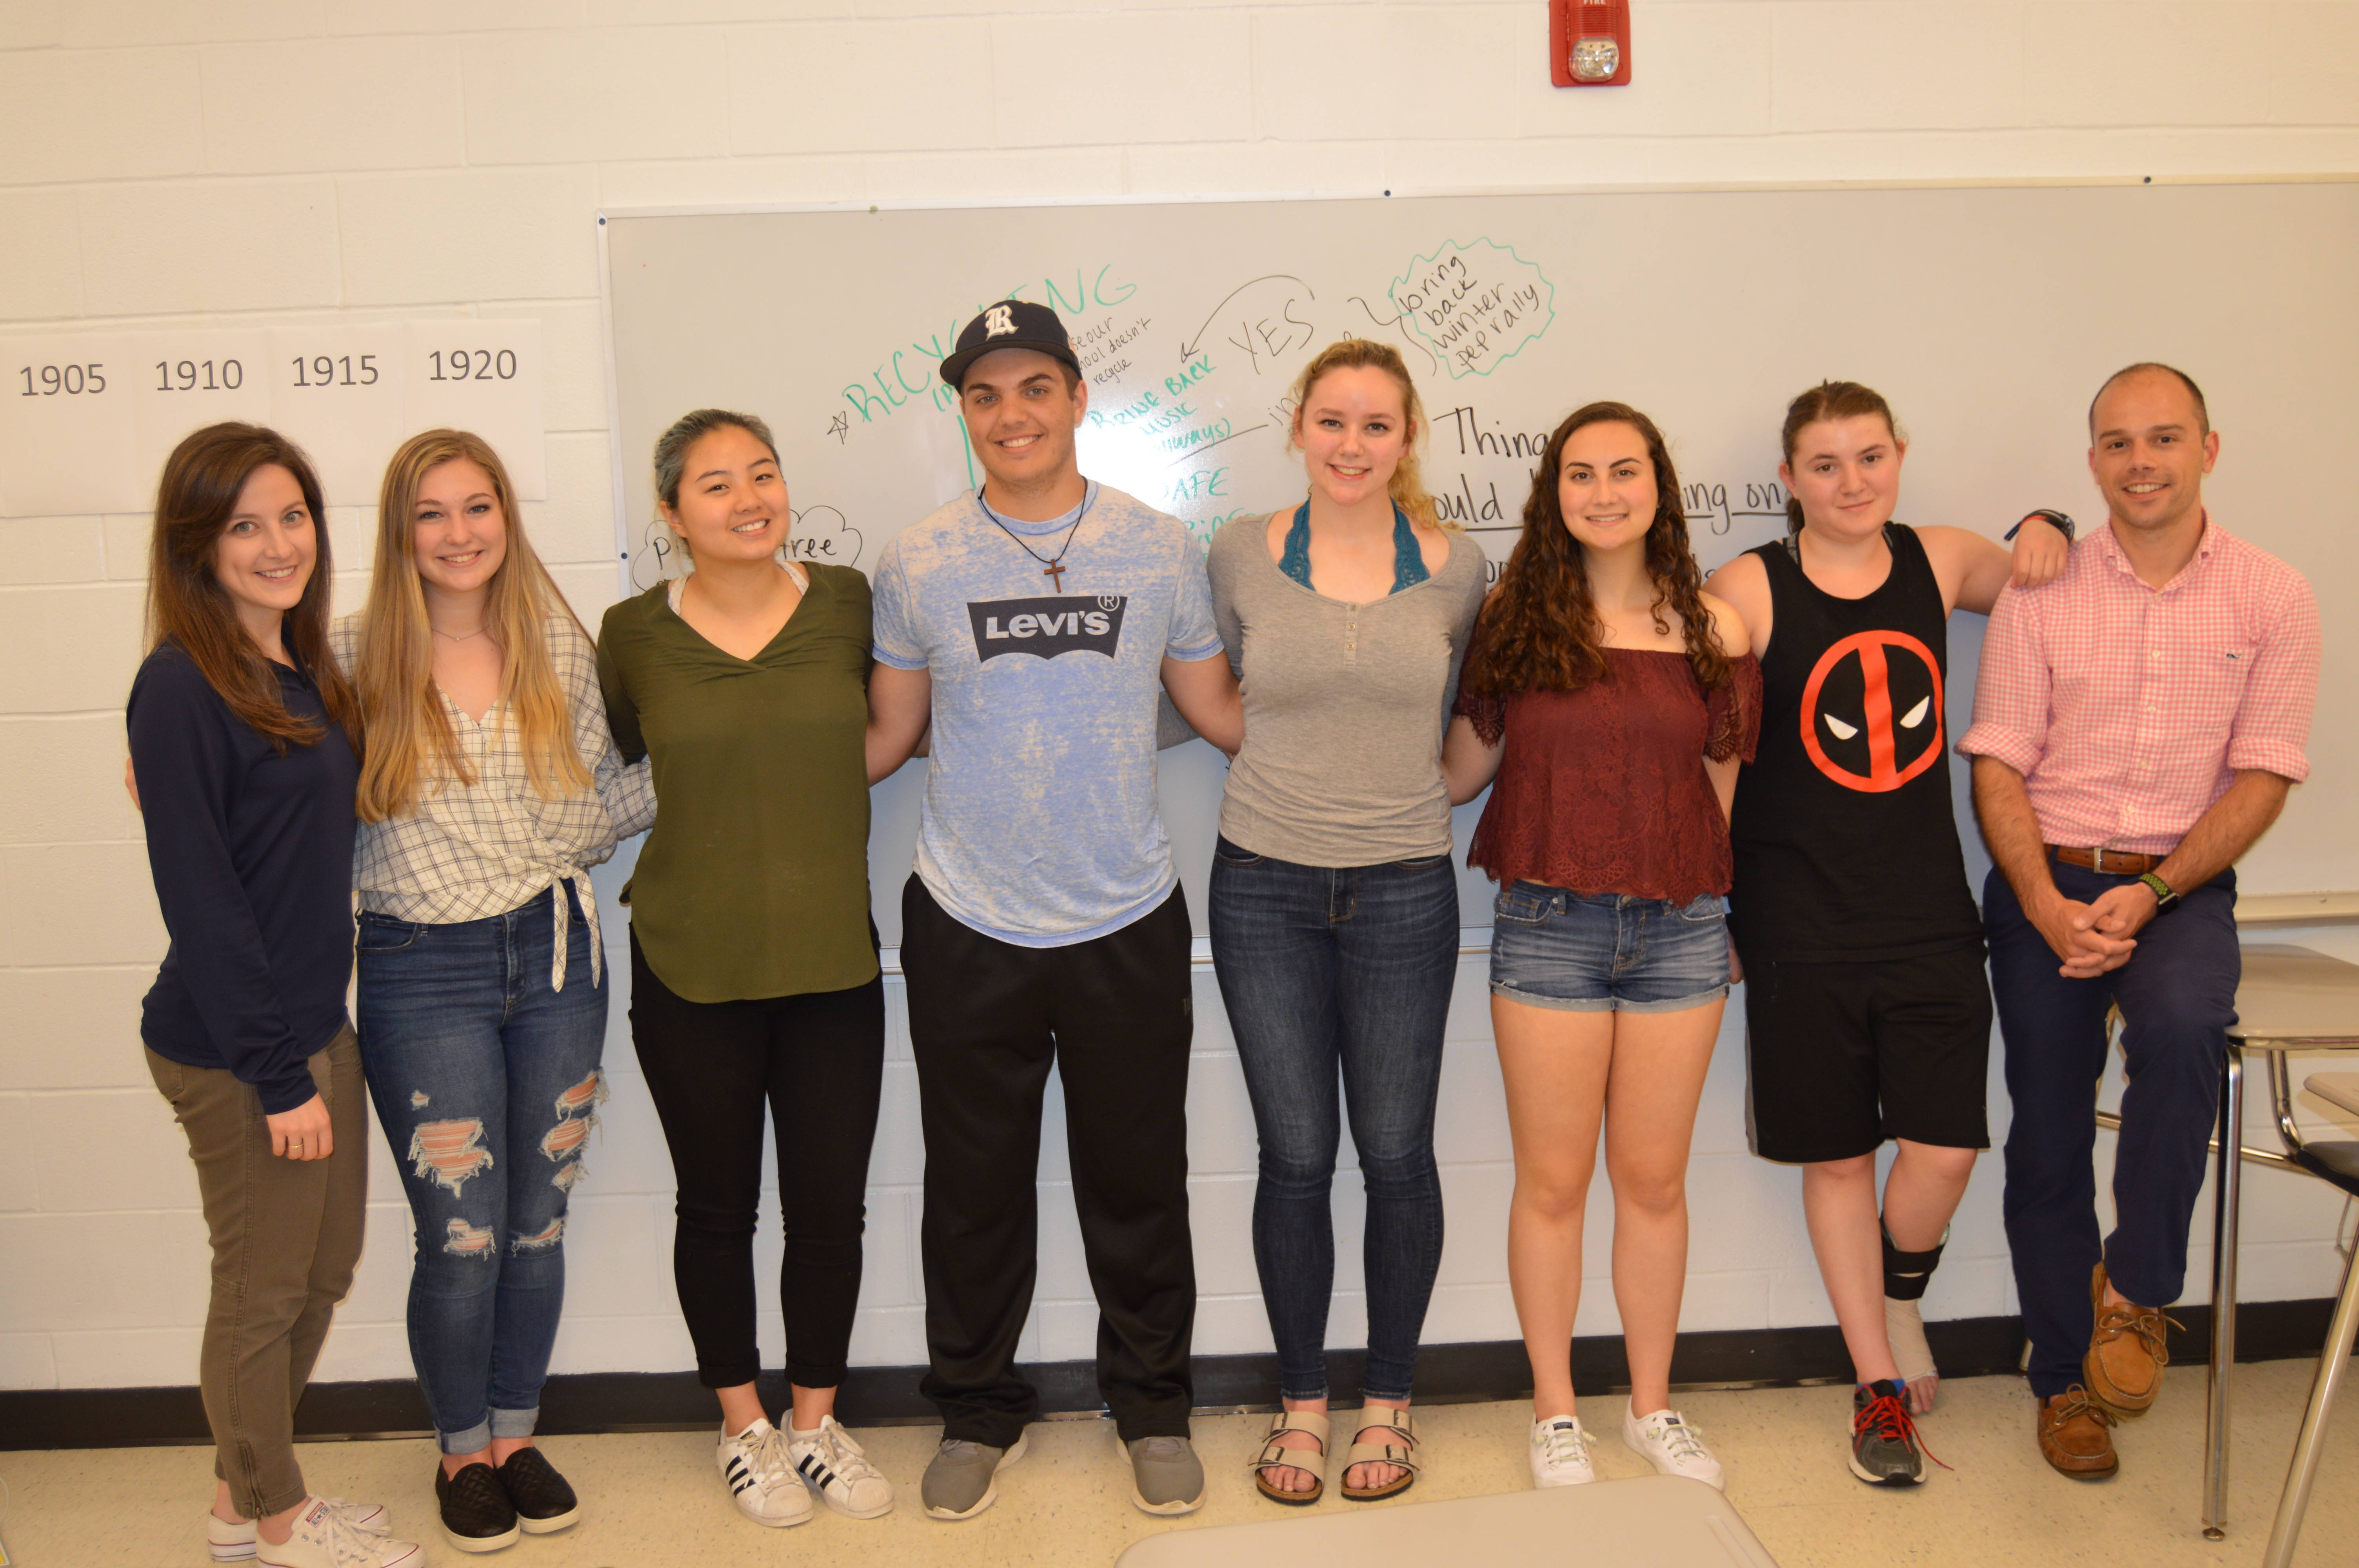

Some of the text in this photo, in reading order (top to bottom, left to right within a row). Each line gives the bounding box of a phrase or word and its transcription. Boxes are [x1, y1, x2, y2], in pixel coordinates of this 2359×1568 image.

[1399, 256, 1466, 314] bring
[1424, 279, 1477, 325] back
[985, 305, 1019, 341] R
[1086, 317, 1112, 343] our
[1109, 318, 1151, 353] doesn't
[1229, 299, 1314, 375] YES
[1434, 283, 1504, 348] winter
[1456, 284, 1539, 370] pep rally
[21, 350, 516, 396] 1905 1910 1915 1920
[1093, 359, 1132, 385] recycle
[1165, 354, 1217, 396] BACK
[1746, 483, 1781, 510] on
